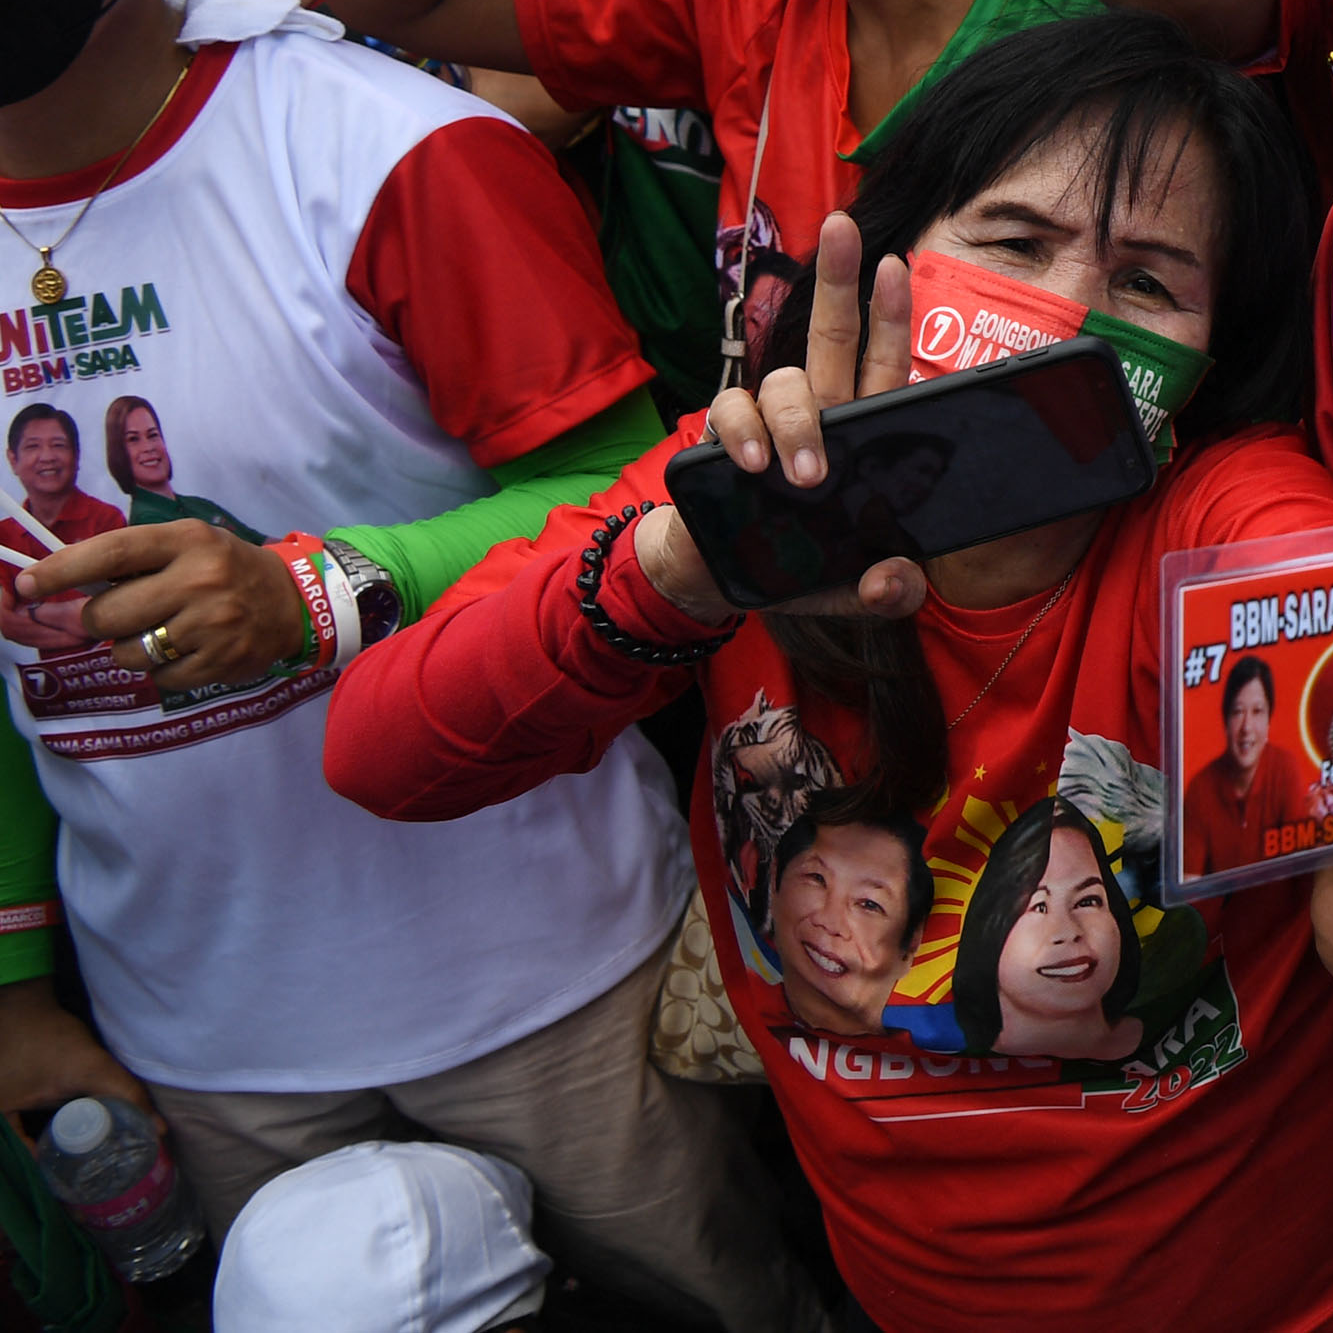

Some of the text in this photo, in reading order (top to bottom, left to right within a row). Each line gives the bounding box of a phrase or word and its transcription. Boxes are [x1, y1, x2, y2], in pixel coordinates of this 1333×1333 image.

[927, 313, 953, 351] 7
[3, 344, 141, 394] BBM-SARA
[1121, 361, 1165, 404] SARA
[291, 557, 335, 641] MARCOS
[27, 670, 46, 697] 7
[1184, 643, 1228, 688] #7
[67, 693, 136, 710] PRESIDENT
[123, 724, 188, 748] TAYONG
[193, 691, 291, 734] BABANGON
[1121, 1023, 1249, 1114] 2022
